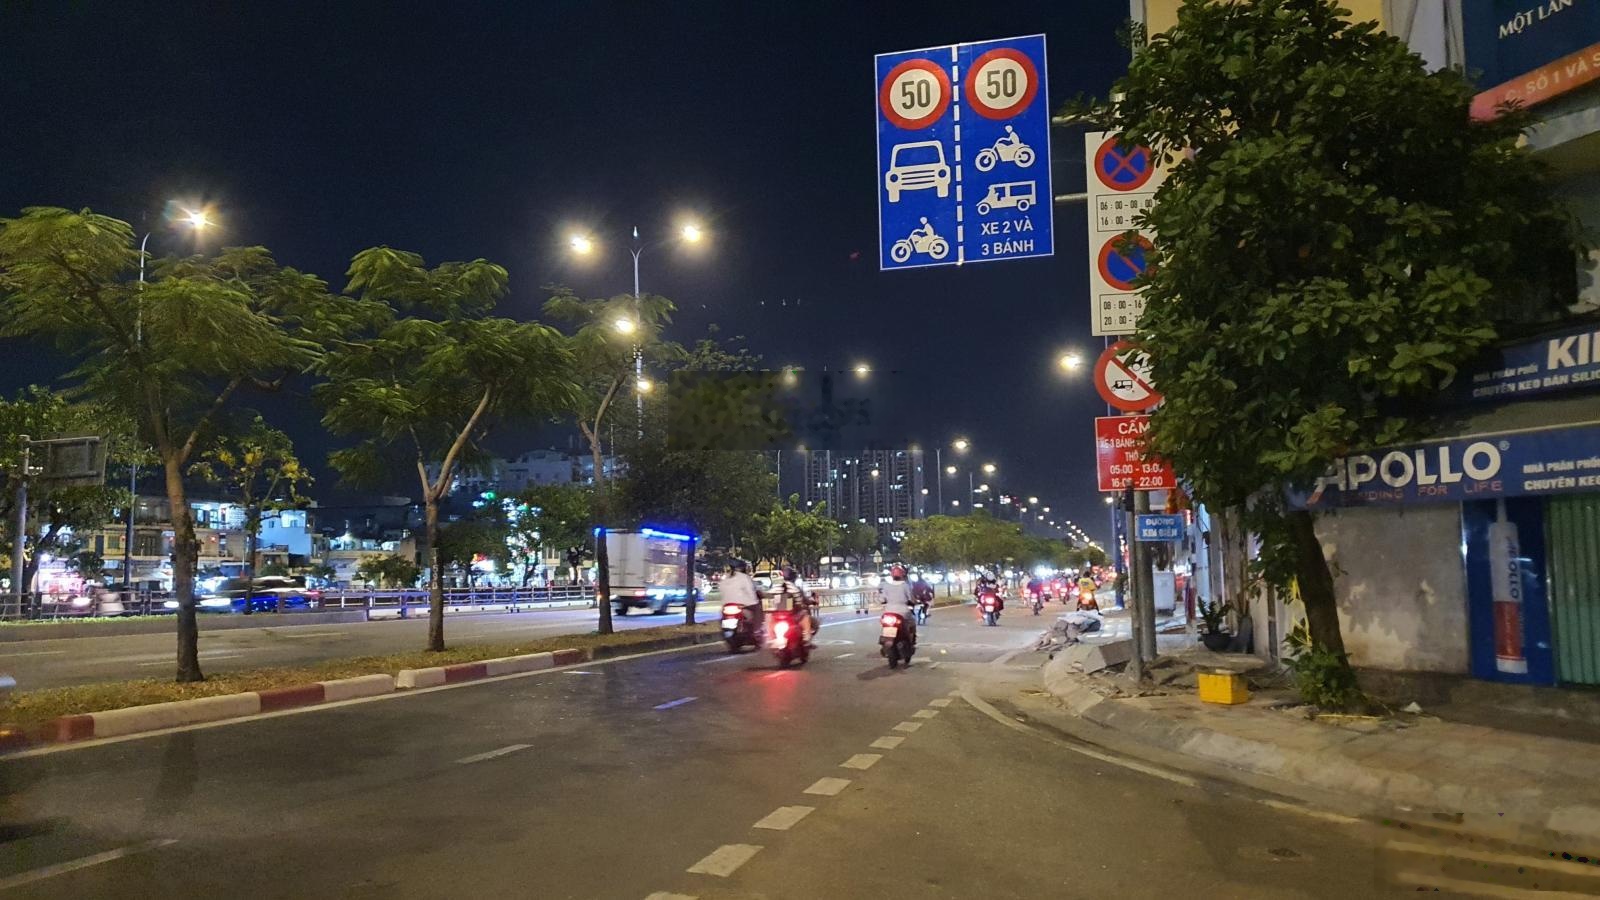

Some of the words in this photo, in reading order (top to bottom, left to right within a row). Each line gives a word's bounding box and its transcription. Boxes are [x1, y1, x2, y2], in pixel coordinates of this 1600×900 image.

[1498, 10, 1535, 39] MỘT
[1565, 57, 1588, 78] VÀ
[986, 68, 1017, 99] 50
[901, 79, 931, 110] 50
[981, 222, 998, 236] XE
[1002, 220, 1010, 234] 2
[1014, 215, 1033, 232] VÀ
[981, 243, 990, 256] 3
[993, 238, 1034, 254] BÁNH
[1118, 417, 1151, 435] CẤM
[1306, 441, 1501, 506] APOLLO
[1524, 476, 1576, 491] CHUYÊN
[1417, 484, 1448, 497] FOR
[1463, 480, 1503, 494] LIFE
